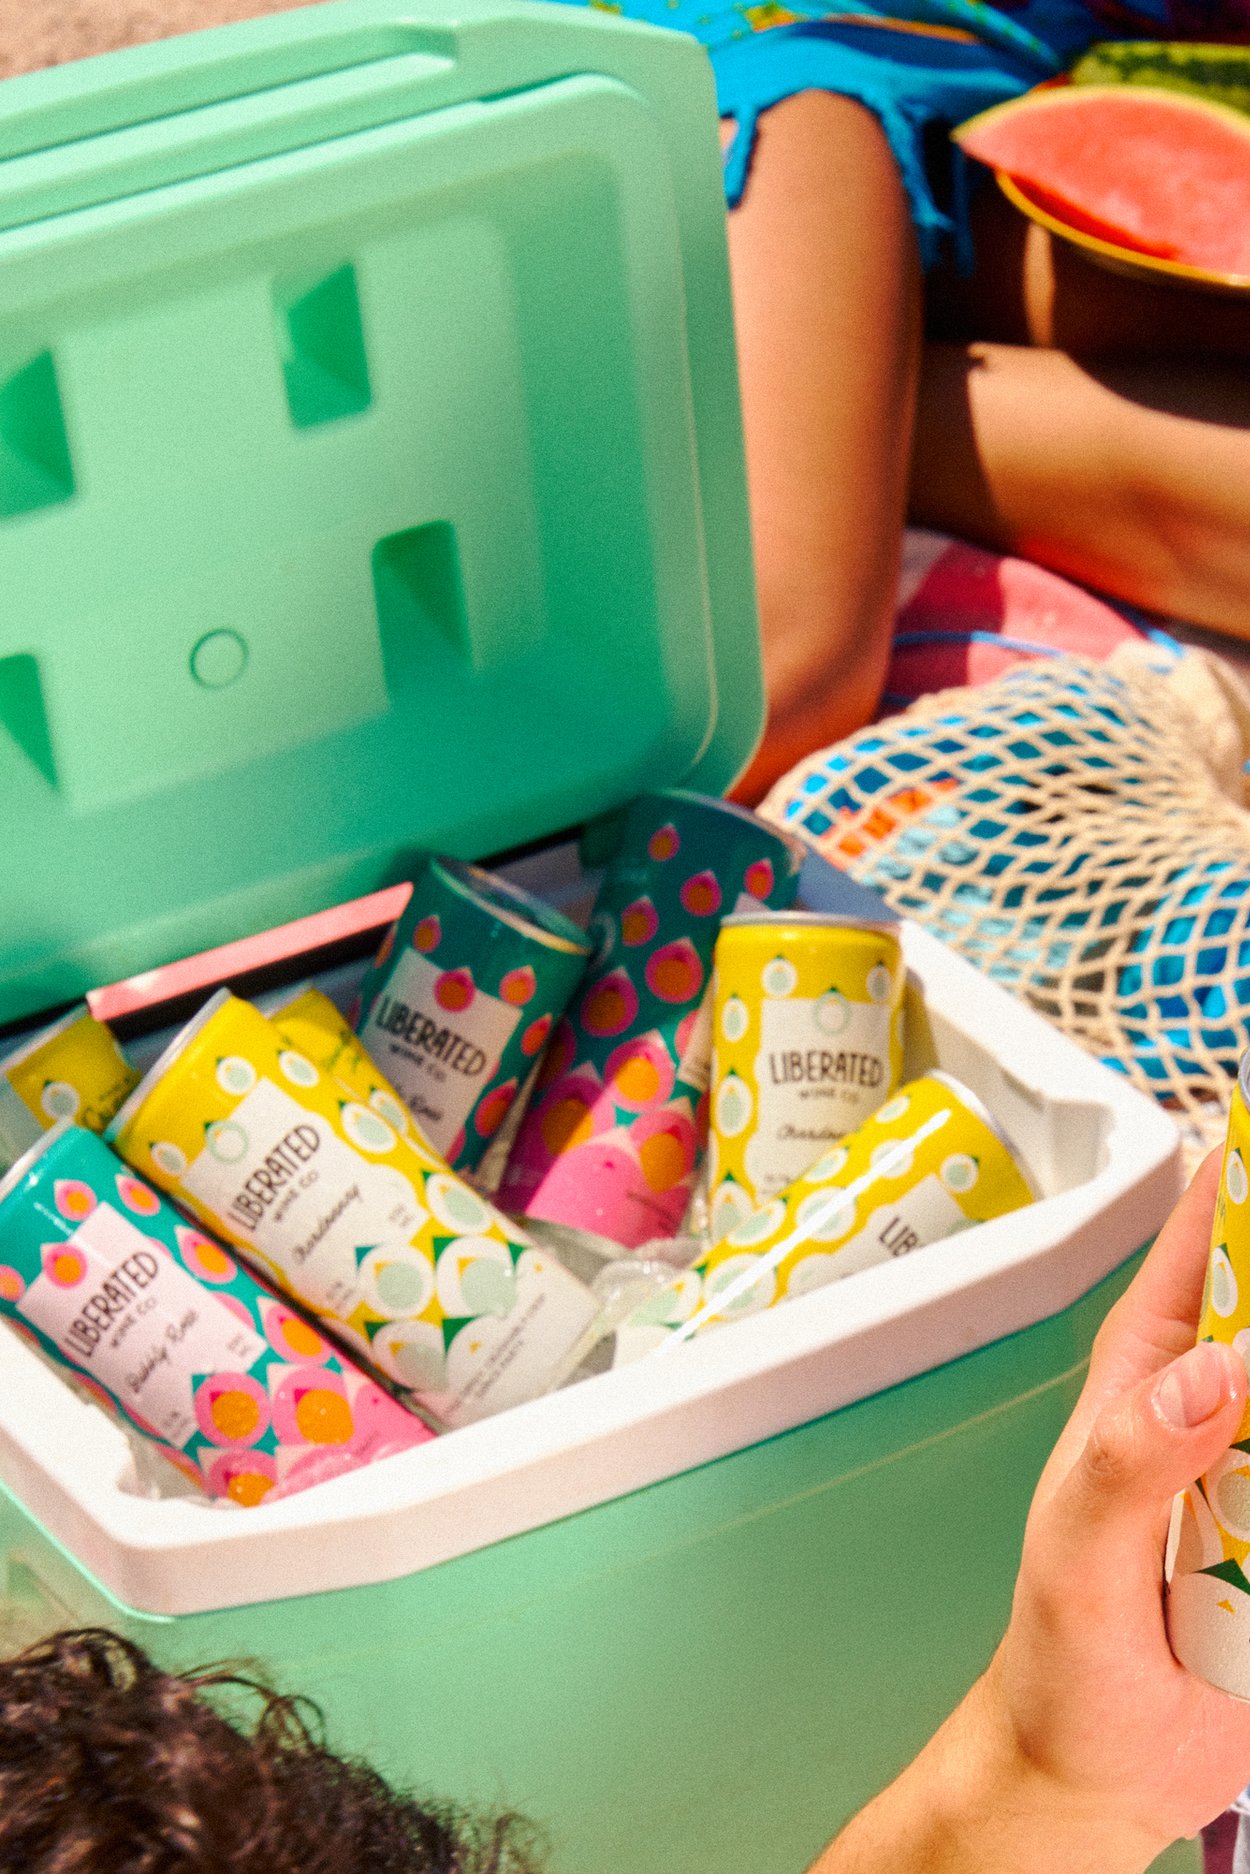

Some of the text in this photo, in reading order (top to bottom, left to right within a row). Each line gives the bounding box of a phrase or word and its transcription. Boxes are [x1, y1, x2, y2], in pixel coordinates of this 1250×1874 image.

[375, 996, 487, 1077] LIBERATED
[769, 1050, 884, 1088] LIBERATED
[226, 1124, 321, 1232] LIBERATED
[63, 1251, 160, 1358] LIBERATED
